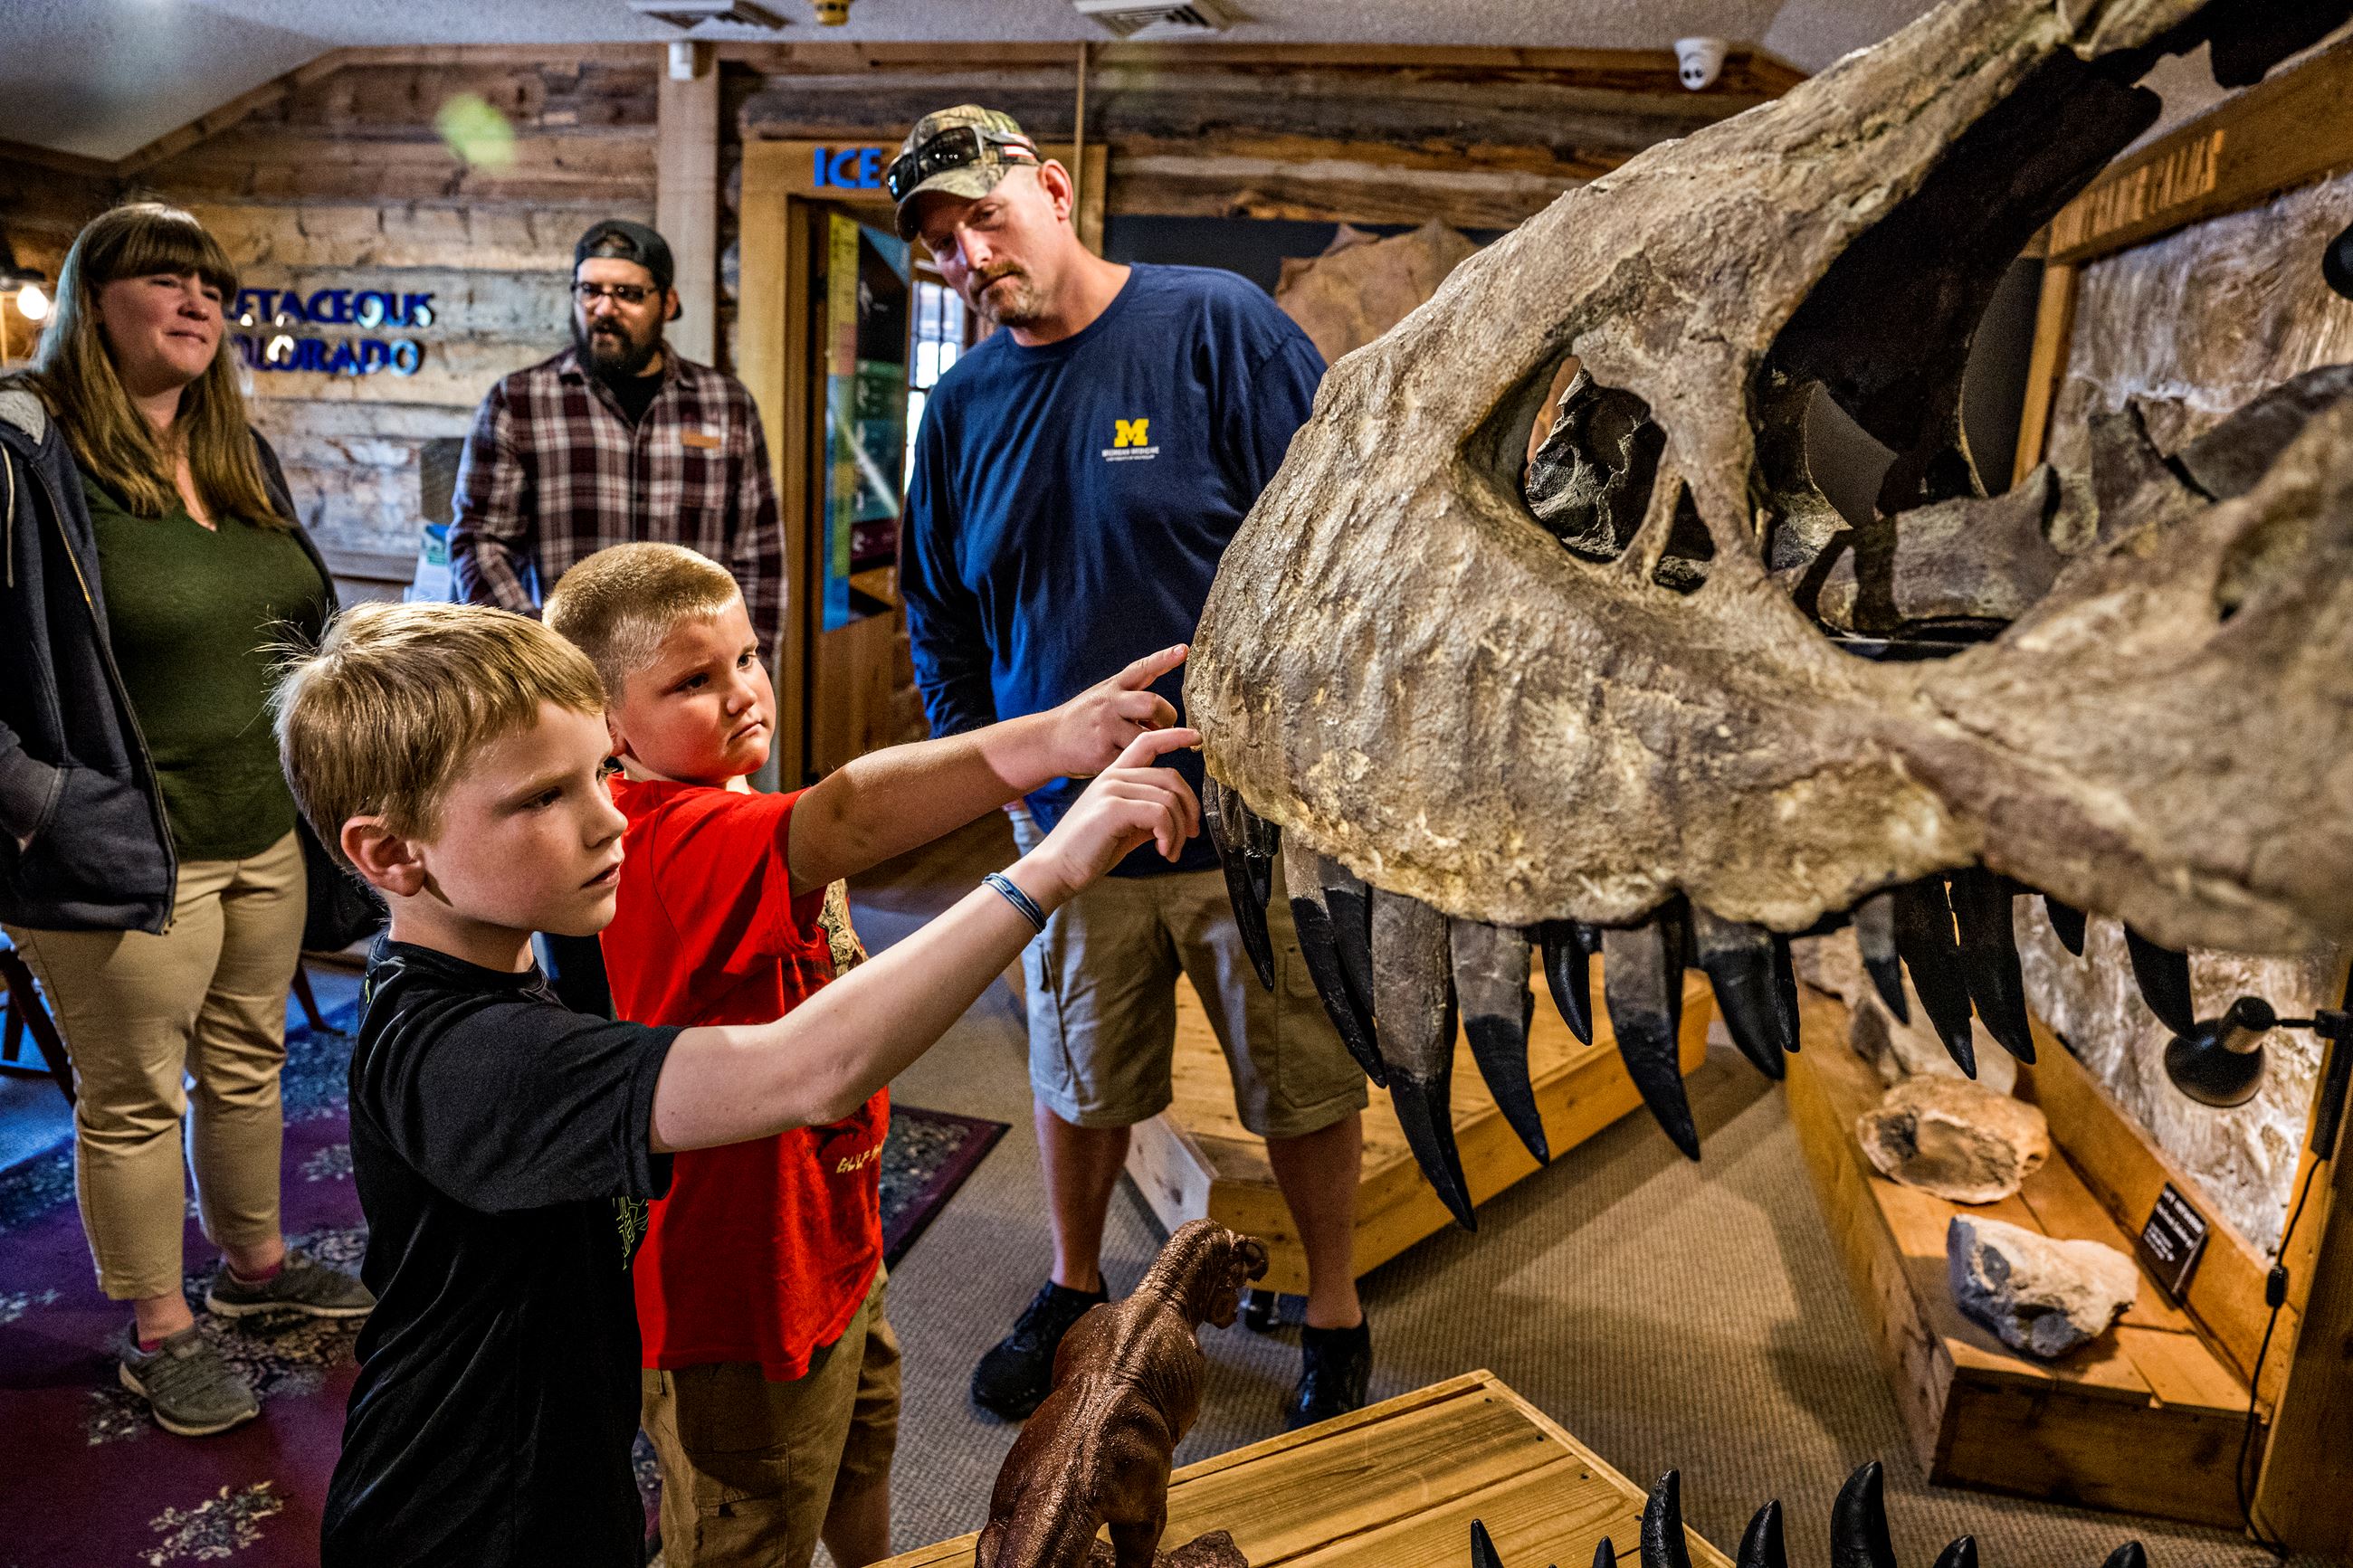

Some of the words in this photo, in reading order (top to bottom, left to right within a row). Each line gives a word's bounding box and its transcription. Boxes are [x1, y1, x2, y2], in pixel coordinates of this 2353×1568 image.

[814, 147, 881, 189] ICE
[226, 289, 435, 328] ETACEOUS
[1114, 418, 1149, 448] M
